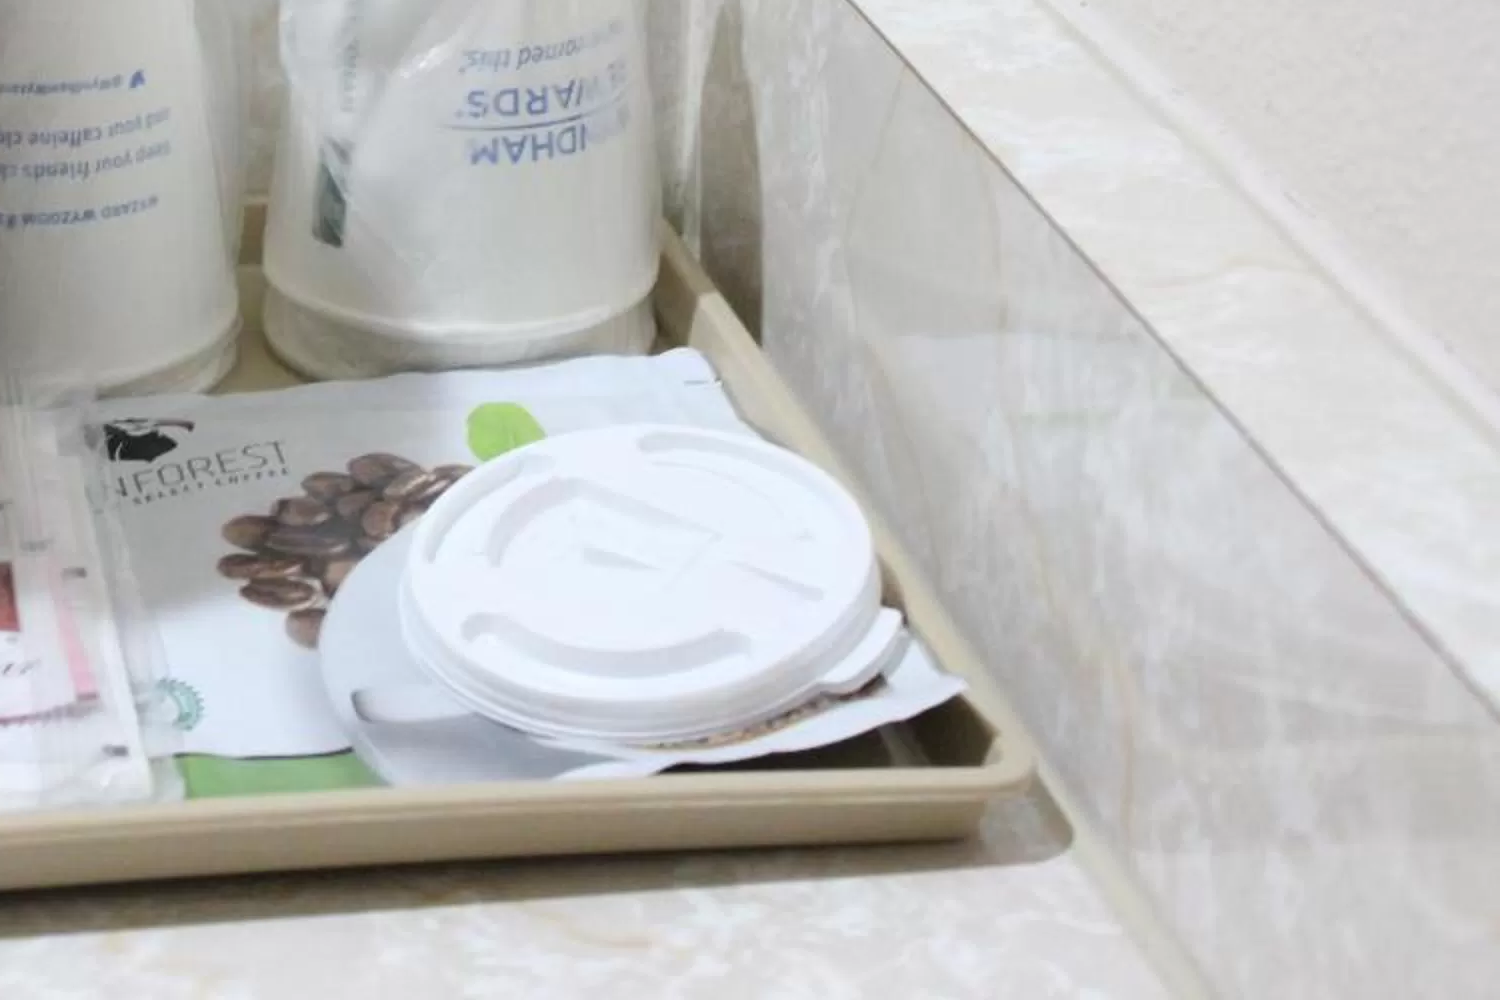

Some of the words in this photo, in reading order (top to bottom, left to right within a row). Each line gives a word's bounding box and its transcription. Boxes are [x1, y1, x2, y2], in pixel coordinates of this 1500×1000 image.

[27, 127, 103, 148] caffeine
[22, 160, 90, 182] friends
[96, 149, 133, 174] your
